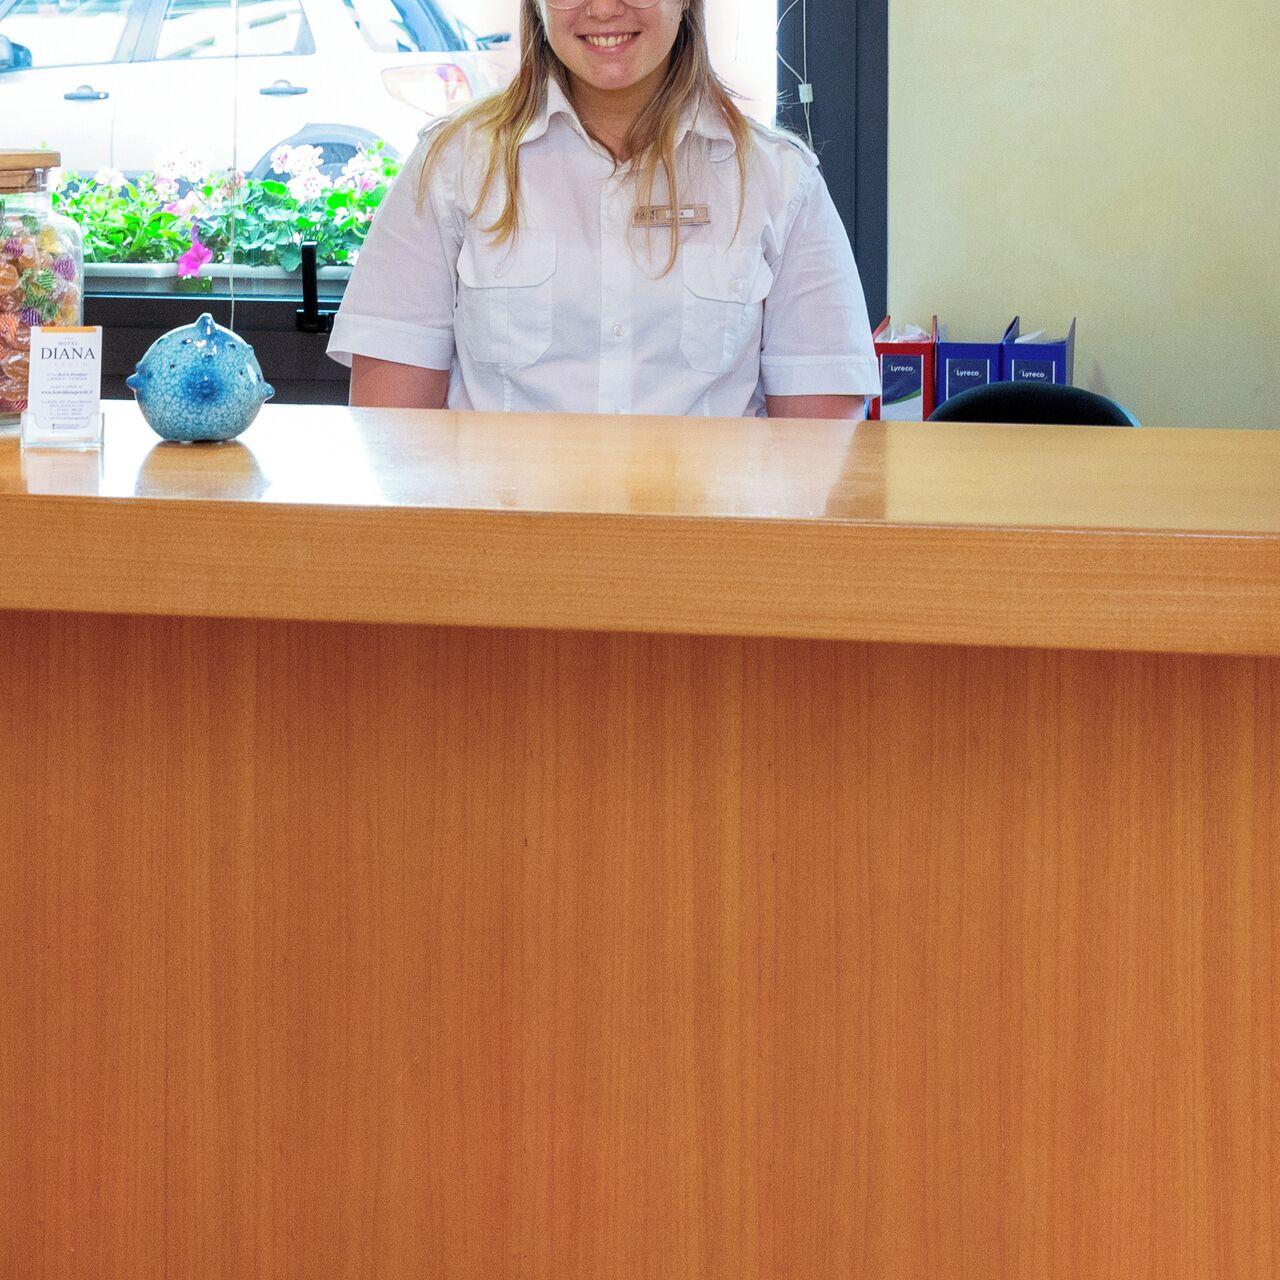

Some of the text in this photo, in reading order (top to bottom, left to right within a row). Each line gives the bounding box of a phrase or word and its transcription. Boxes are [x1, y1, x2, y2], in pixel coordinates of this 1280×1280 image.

[40, 347, 96, 360] DIANA
[890, 364, 914, 373] Lyreco
[956, 369, 980, 378] Lyreco
[1021, 370, 1045, 379] Lyreco
